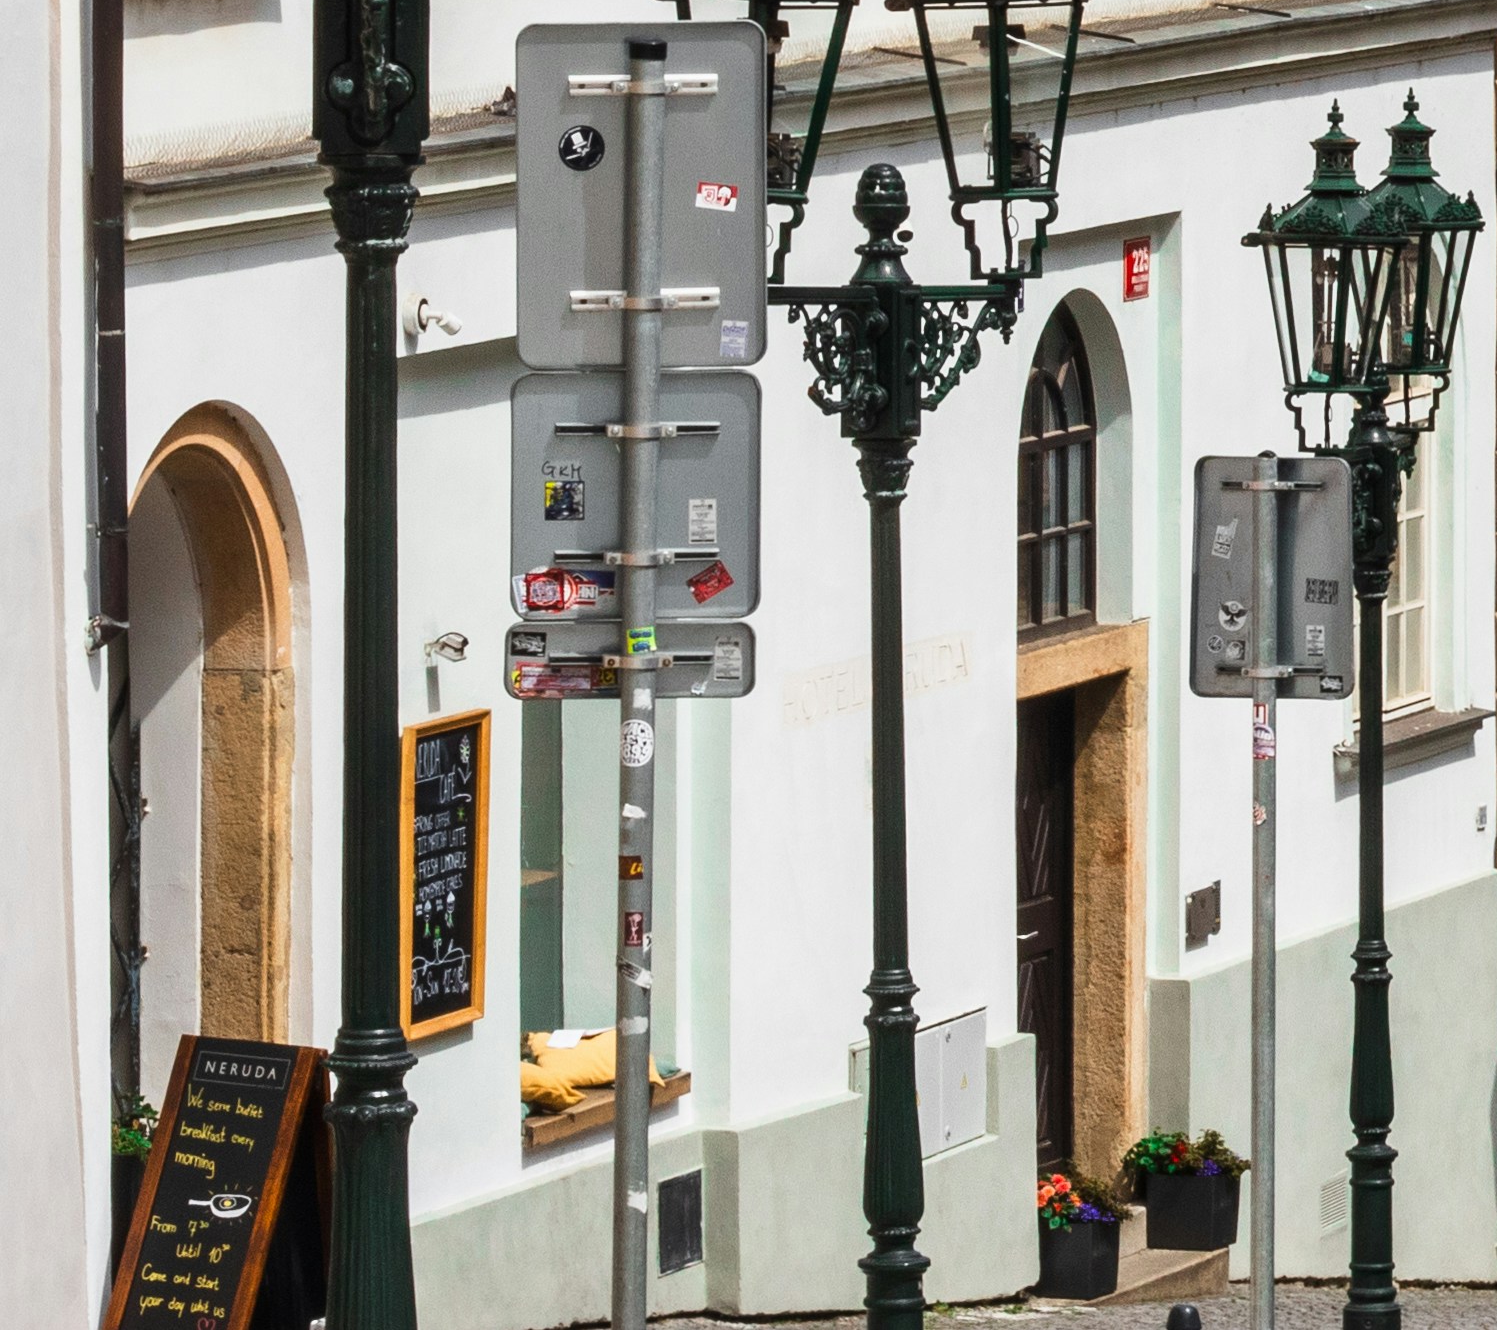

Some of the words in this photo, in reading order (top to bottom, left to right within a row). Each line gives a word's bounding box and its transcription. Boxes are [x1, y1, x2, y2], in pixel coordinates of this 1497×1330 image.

[204, 1061, 277, 1080] NERUDA
[187, 1083, 204, 1108] We
[236, 1096, 263, 1119] buffet
[180, 1121, 226, 1144] breakfast
[231, 1134, 255, 1153] every
[175, 1151, 215, 1179] morning
[150, 1215, 177, 1233] From
[141, 1263, 168, 1283] Come
[173, 1272, 190, 1286] and
[195, 1275, 220, 1291] start
[140, 1295, 165, 1316] your
[168, 1297, 185, 1318] day
[213, 1306, 225, 1318] us
